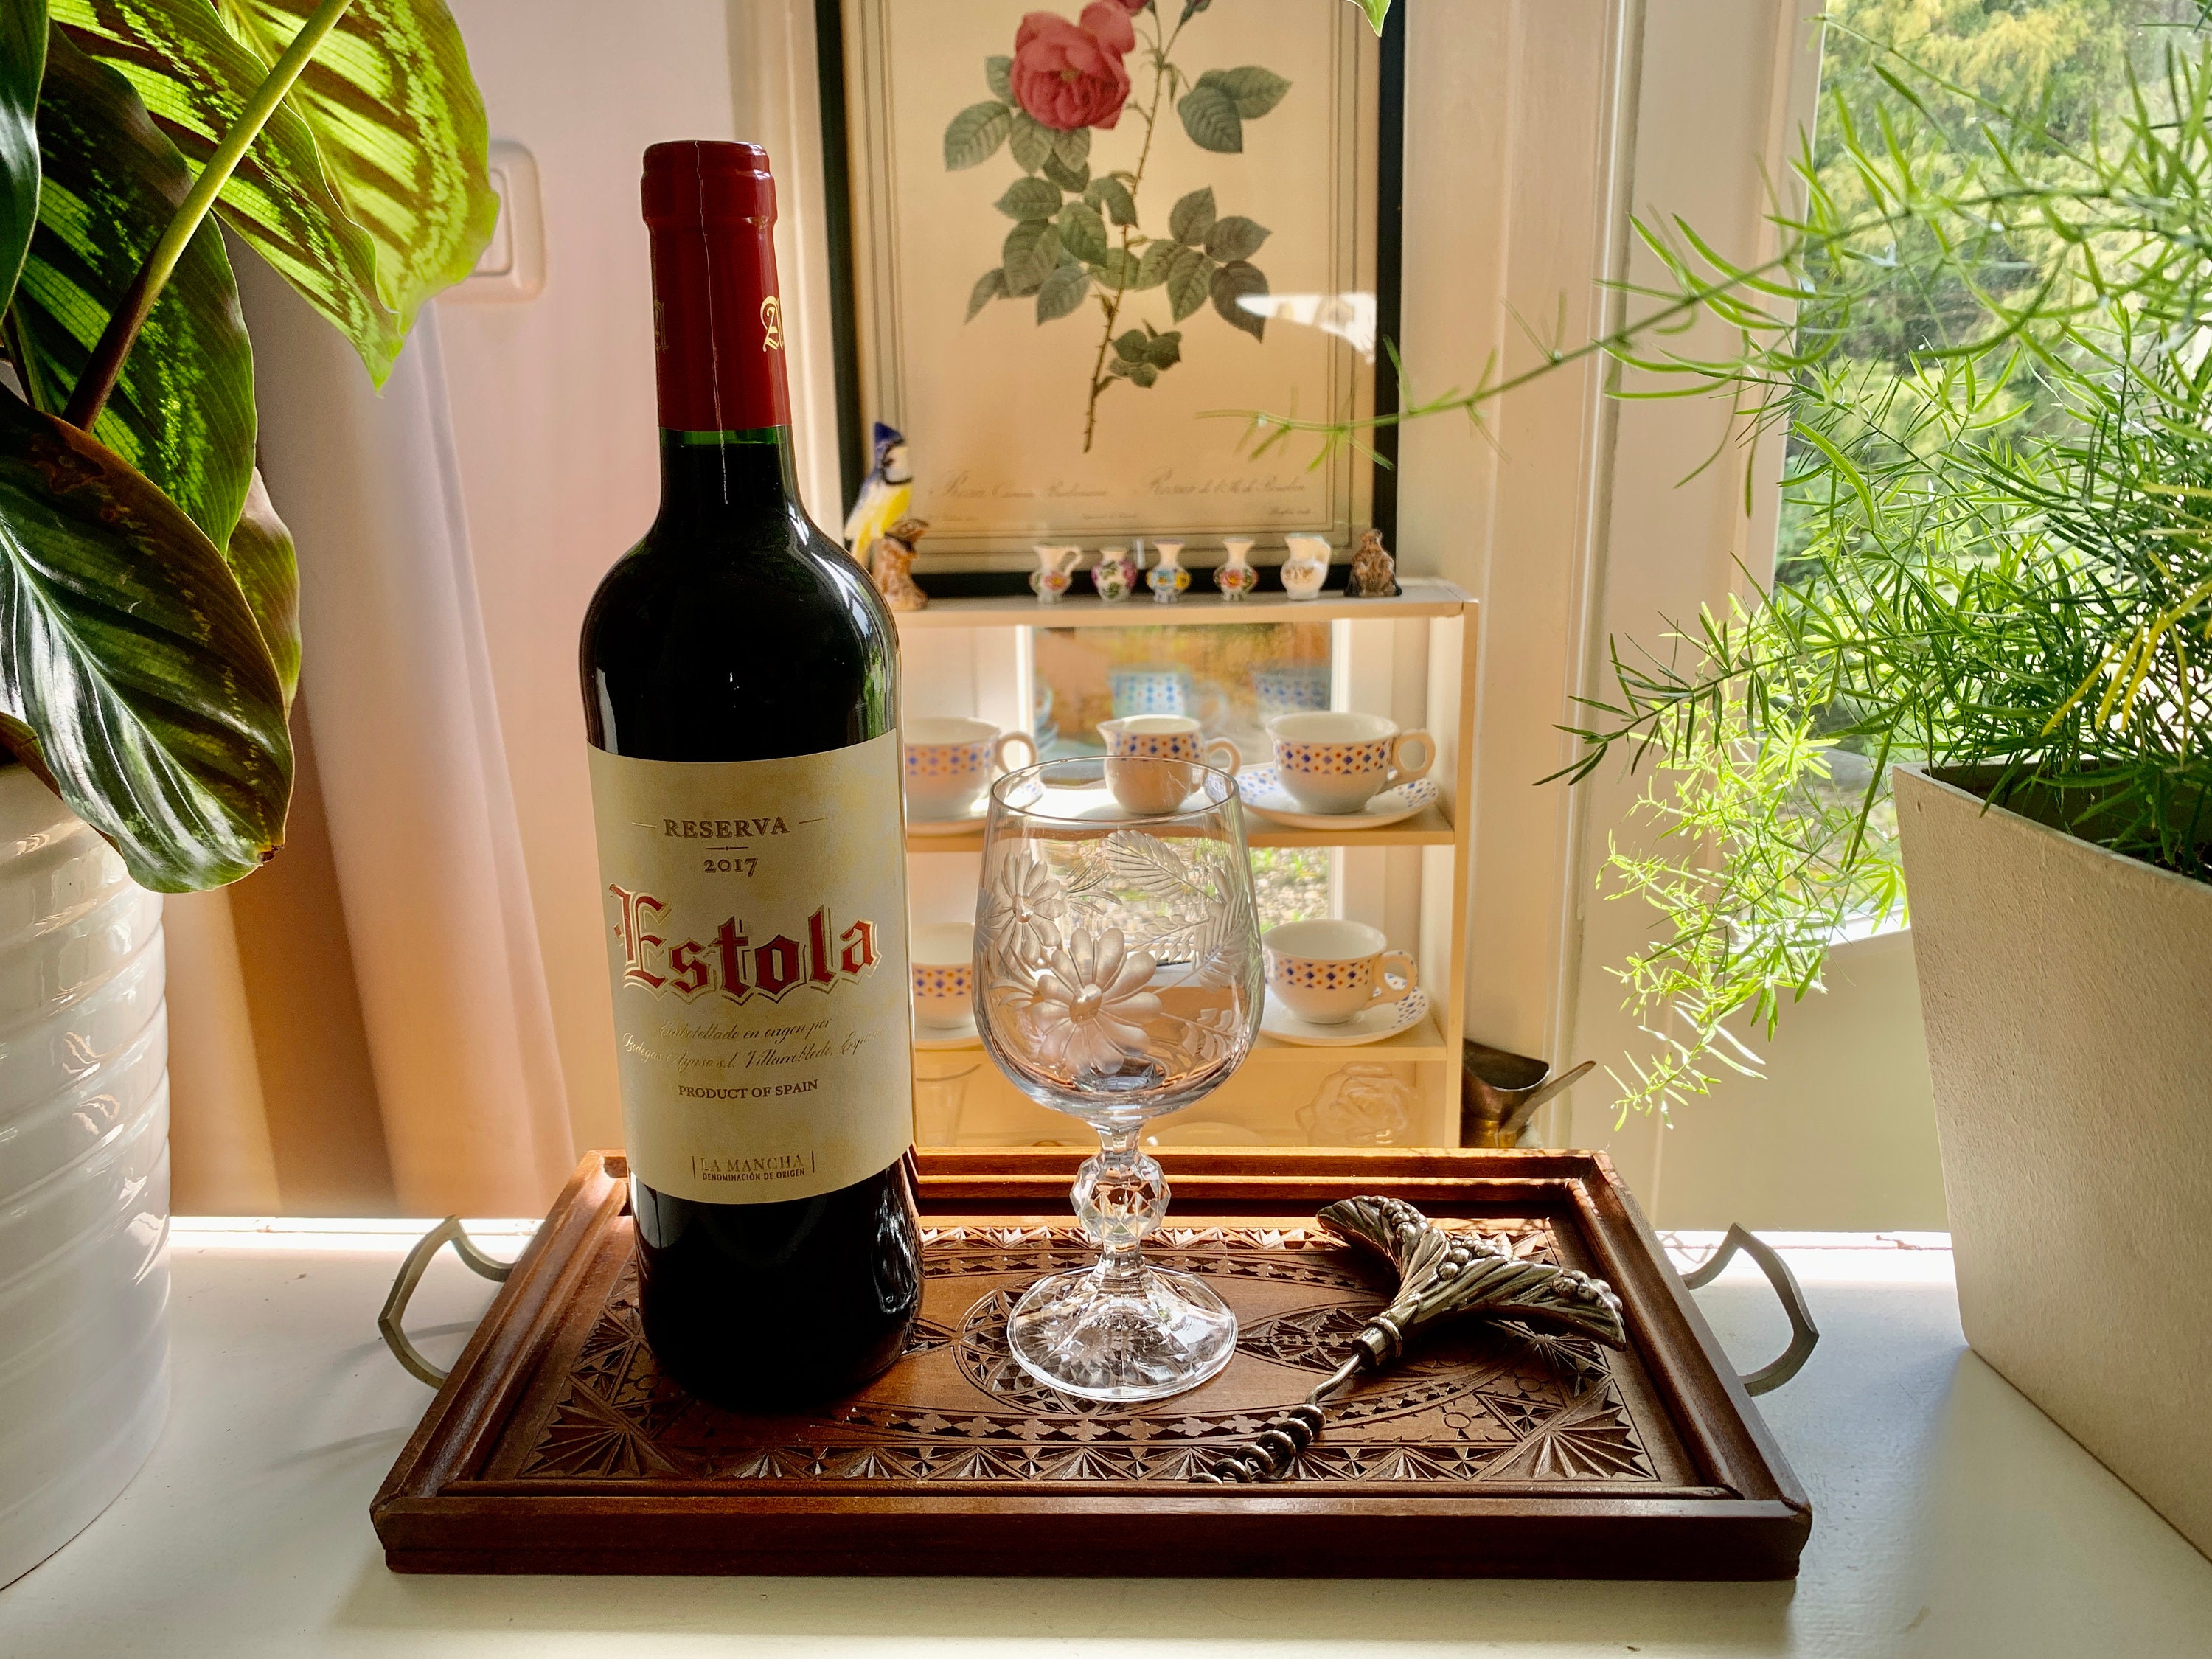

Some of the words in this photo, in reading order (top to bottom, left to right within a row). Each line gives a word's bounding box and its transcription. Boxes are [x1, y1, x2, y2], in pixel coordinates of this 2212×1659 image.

[664, 816, 790, 839] RESERVA
[704, 858, 758, 877] 2017
[609, 883, 883, 1006] Estola
[764, 1024, 807, 1045] origen
[622, 1032, 662, 1063] Bodegas
[678, 1085, 748, 1099] PRODUCT
[751, 1087, 772, 1098] OF
[775, 1079, 818, 1096] SPAIN
[700, 1158, 721, 1172] LA
[726, 1154, 804, 1172] MANCHA
[702, 1172, 761, 1181] DENOMINACIÓN
[763, 1172, 773, 1180] DE
[776, 1168, 805, 1180] ORIGEN
